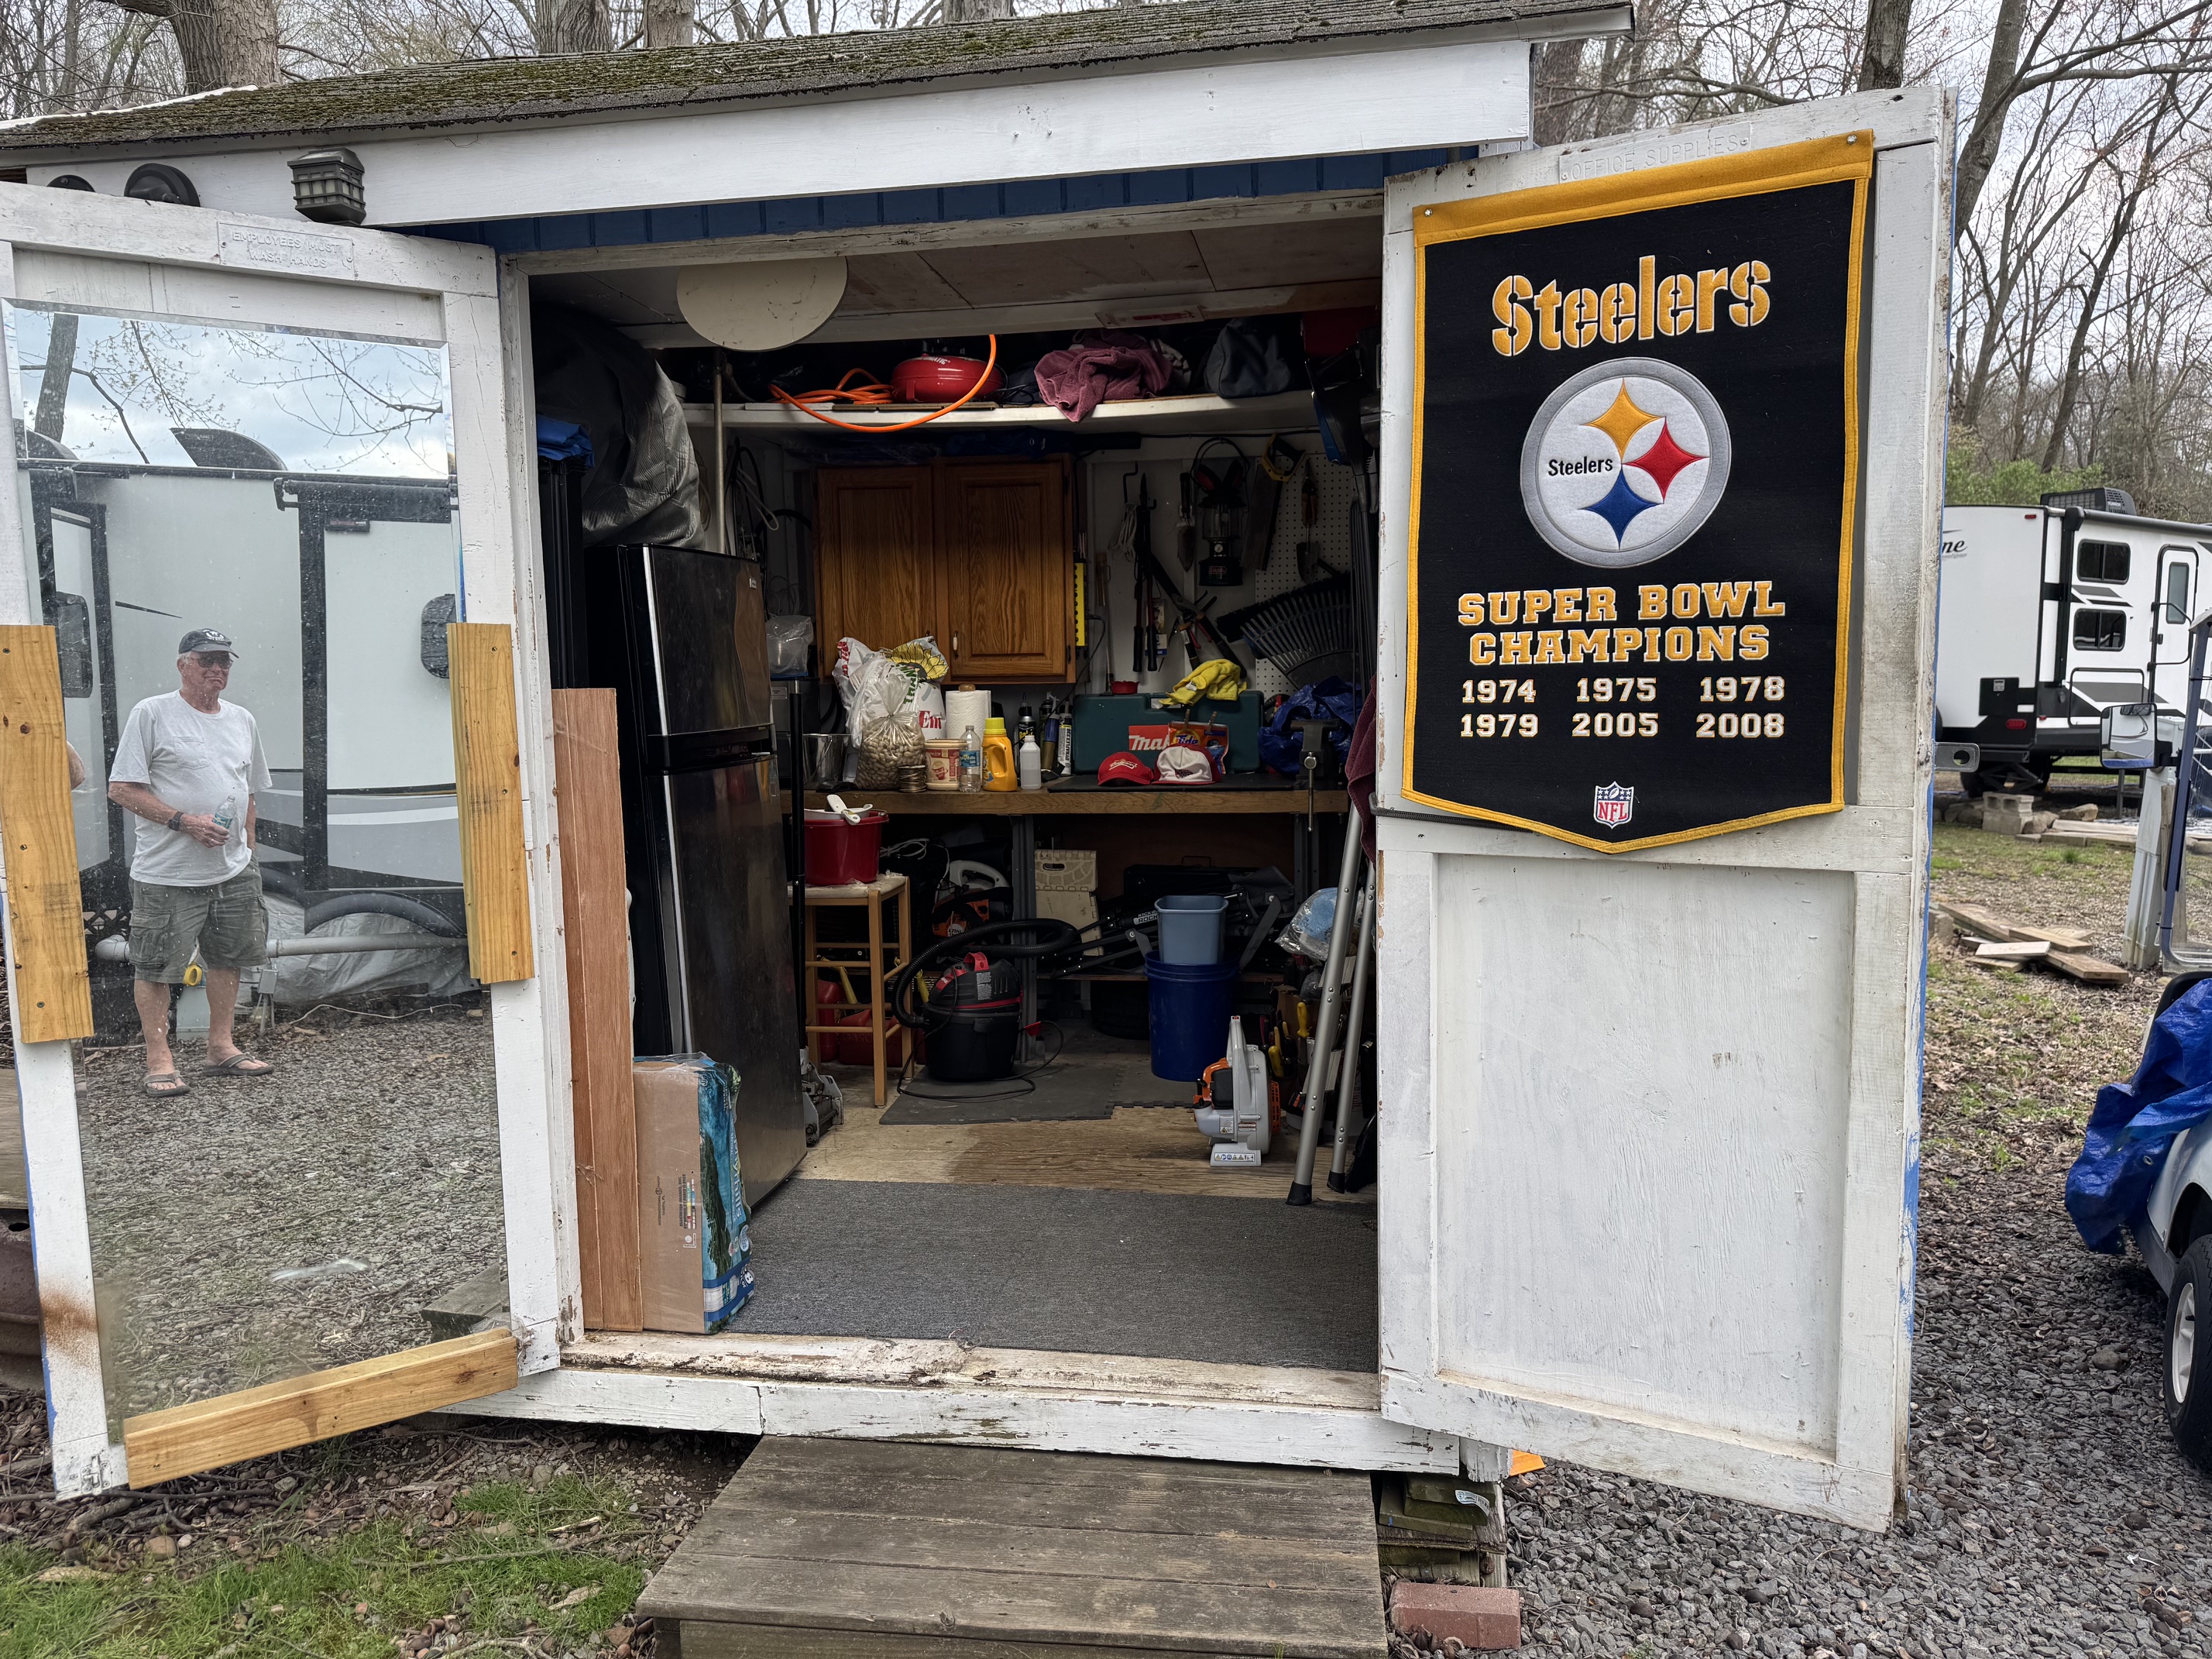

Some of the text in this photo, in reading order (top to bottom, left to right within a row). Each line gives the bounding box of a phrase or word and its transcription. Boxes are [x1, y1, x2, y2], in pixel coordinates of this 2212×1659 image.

[1570, 133, 1739, 181] OFFICE SUPPLIES
[232, 232, 341, 254] EMPLOYEES MUST
[248, 249, 328, 269] WASH HANDS
[1491, 255, 1771, 357] Steelers
[1547, 455, 1613, 477] Steelers
[1942, 540, 1968, 554] ne
[1458, 580, 1787, 627] SUPER BOWL
[1468, 624, 1770, 666] CHAMPIONS
[1461, 675, 1786, 704] 1974 1975 1978
[1460, 712, 1785, 739] 1979 2005 2008
[1128, 734, 1170, 750] Mak
[1176, 734, 1199, 744] Tide
[1598, 802, 1629, 822] NFL
[1139, 914, 1158, 923] ROCK
[733, 1135, 743, 1218] phyrhills
